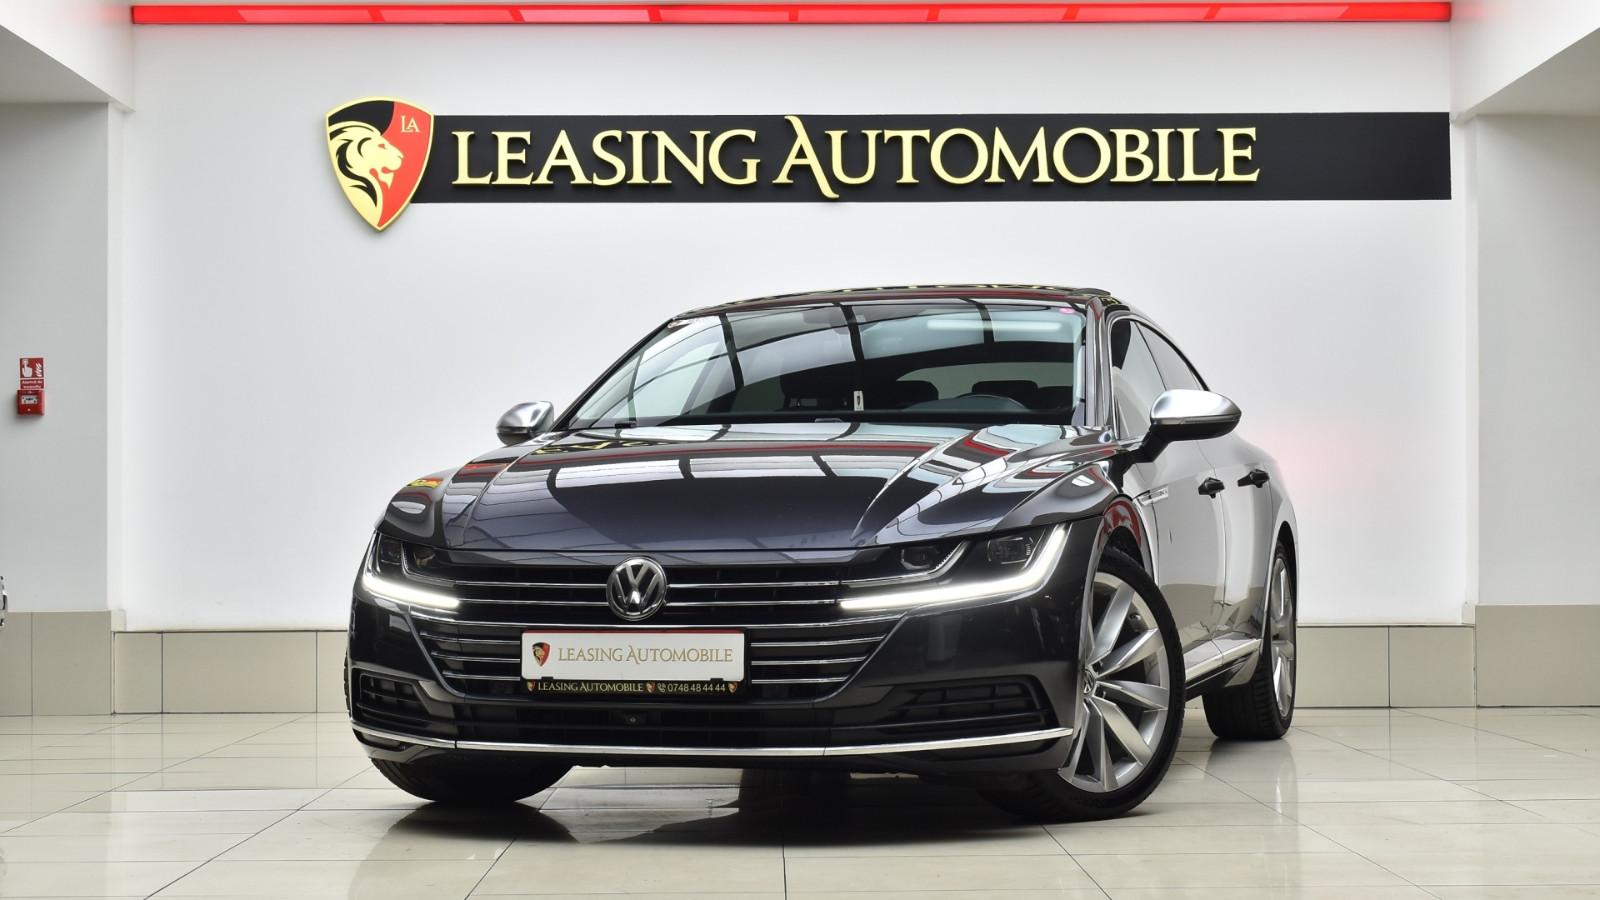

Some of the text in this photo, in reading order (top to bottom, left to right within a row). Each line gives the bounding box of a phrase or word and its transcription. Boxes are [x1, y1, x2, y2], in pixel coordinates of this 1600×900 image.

[400, 115, 420, 133] LA
[451, 115, 1260, 199] LEASING AUTOMOBILE
[558, 645, 733, 664] LEASING AUTOMOBILE
[538, 681, 578, 691] LEASING
[580, 681, 644, 692] AUTOMOBILE
